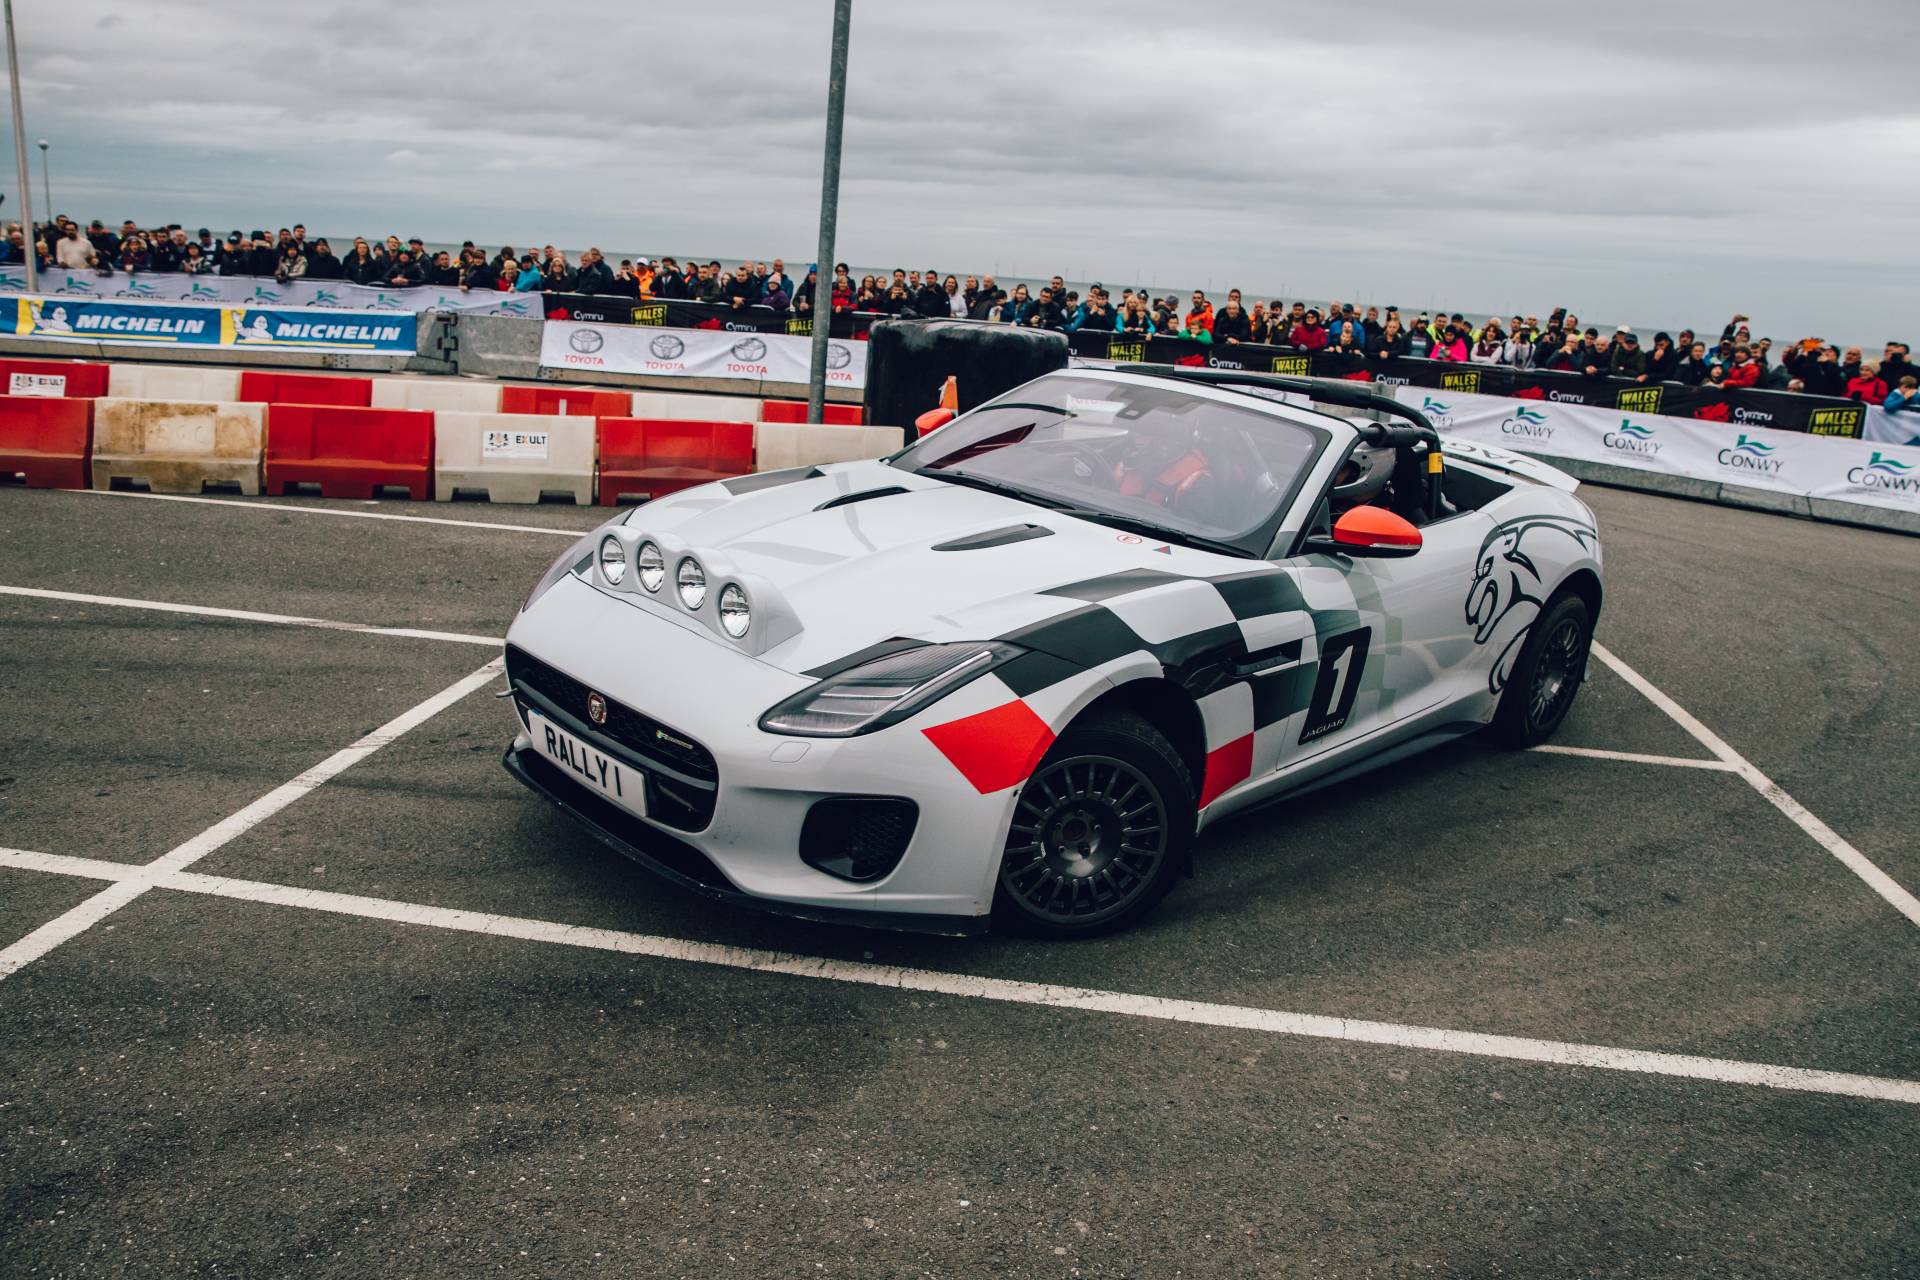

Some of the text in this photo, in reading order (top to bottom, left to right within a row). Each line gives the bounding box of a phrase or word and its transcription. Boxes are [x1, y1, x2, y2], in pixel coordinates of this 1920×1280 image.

[573, 310, 604, 321] Cymru
[634, 307, 663, 321] WALES
[75, 314, 205, 334] MICHELIN
[725, 321, 757, 332] Cymru
[788, 319, 813, 332] WALE
[276, 322, 401, 341] MICHELIN
[1110, 343, 1142, 356] WALES
[564, 354, 605, 366] TOYOTA
[645, 360, 685, 371] TOYOTA
[1209, 356, 1242, 369] Cymru
[1276, 359, 1308, 372] WALES
[726, 362, 768, 374] TOYOTA
[825, 371, 853, 381] YOTA
[1376, 373, 1410, 385] Cymru
[1444, 373, 1477, 387] WALES
[1549, 389, 1584, 403] Cymru
[1621, 390, 1658, 404] WALES
[1734, 407, 1773, 421] Cymru
[1815, 411, 1857, 425] WALES
[1501, 418, 1556, 439] CONWY
[1603, 432, 1663, 454] CONWY
[1717, 448, 1784, 473] CONWY
[1847, 466, 1920, 493] CONWY
[1326, 644, 1354, 716] 1
[1302, 717, 1345, 740] JAGUAR
